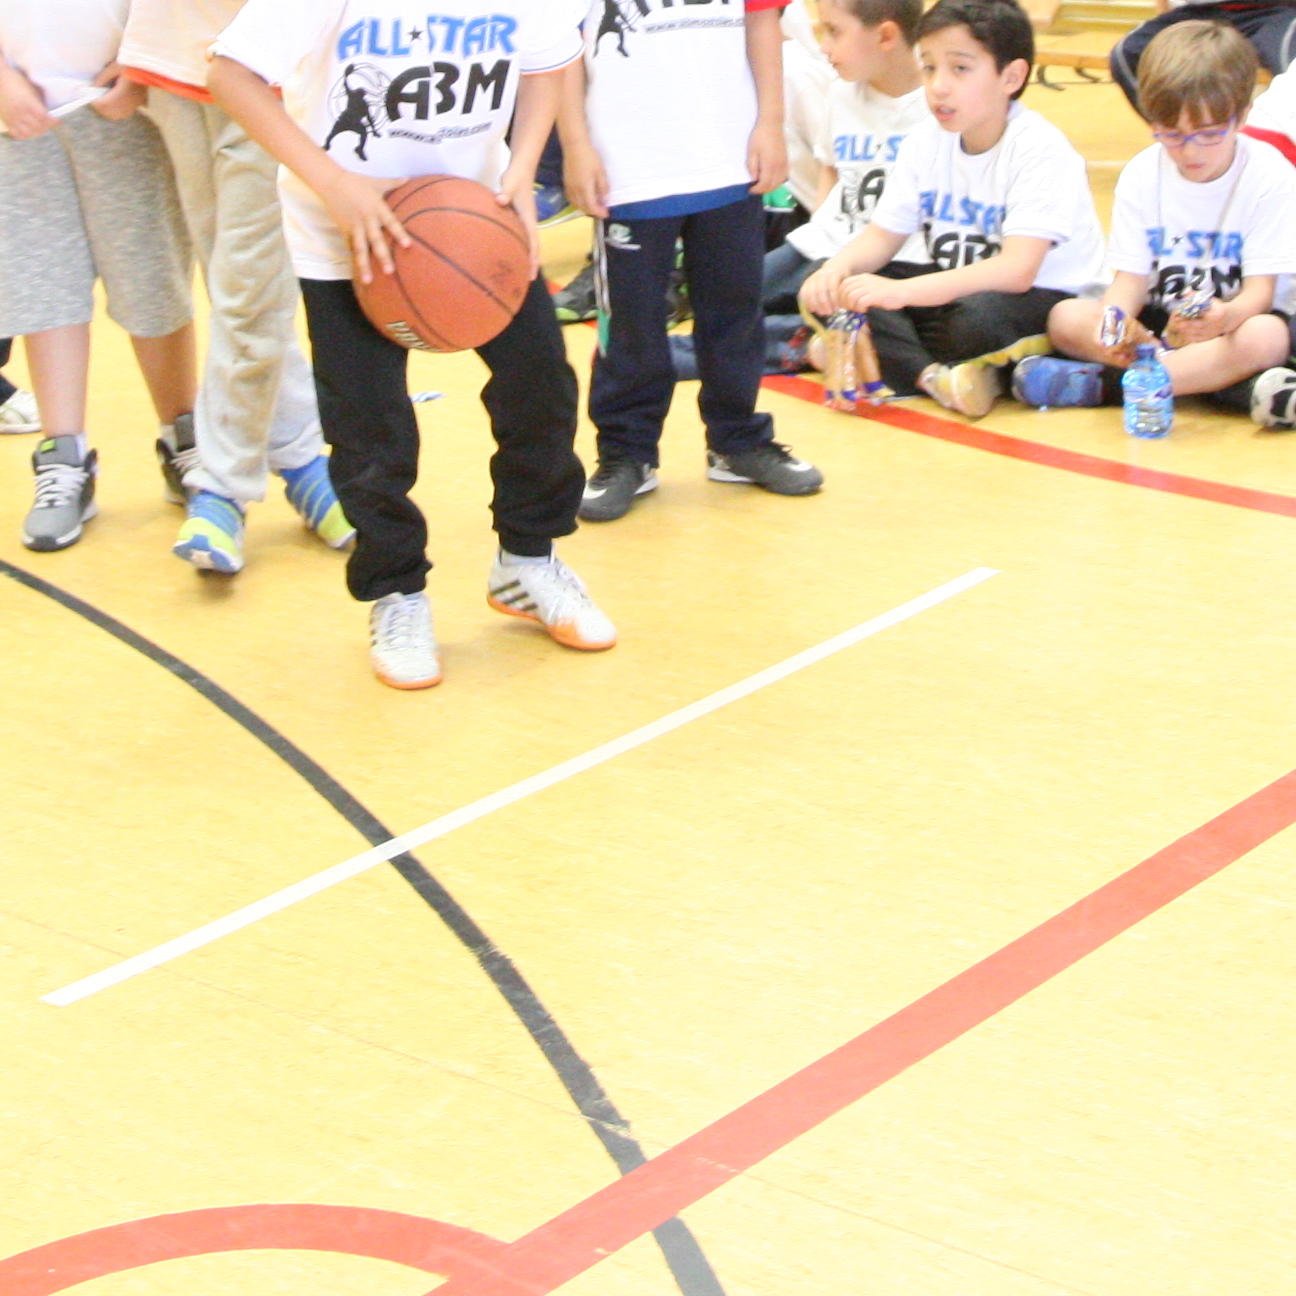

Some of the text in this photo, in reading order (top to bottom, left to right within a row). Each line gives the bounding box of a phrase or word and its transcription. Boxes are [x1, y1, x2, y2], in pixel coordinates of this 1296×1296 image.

[338, 15, 517, 63] ALL STAR
[385, 59, 511, 122] ABM
[834, 134, 875, 161] ALL
[933, 231, 1002, 270] AB
